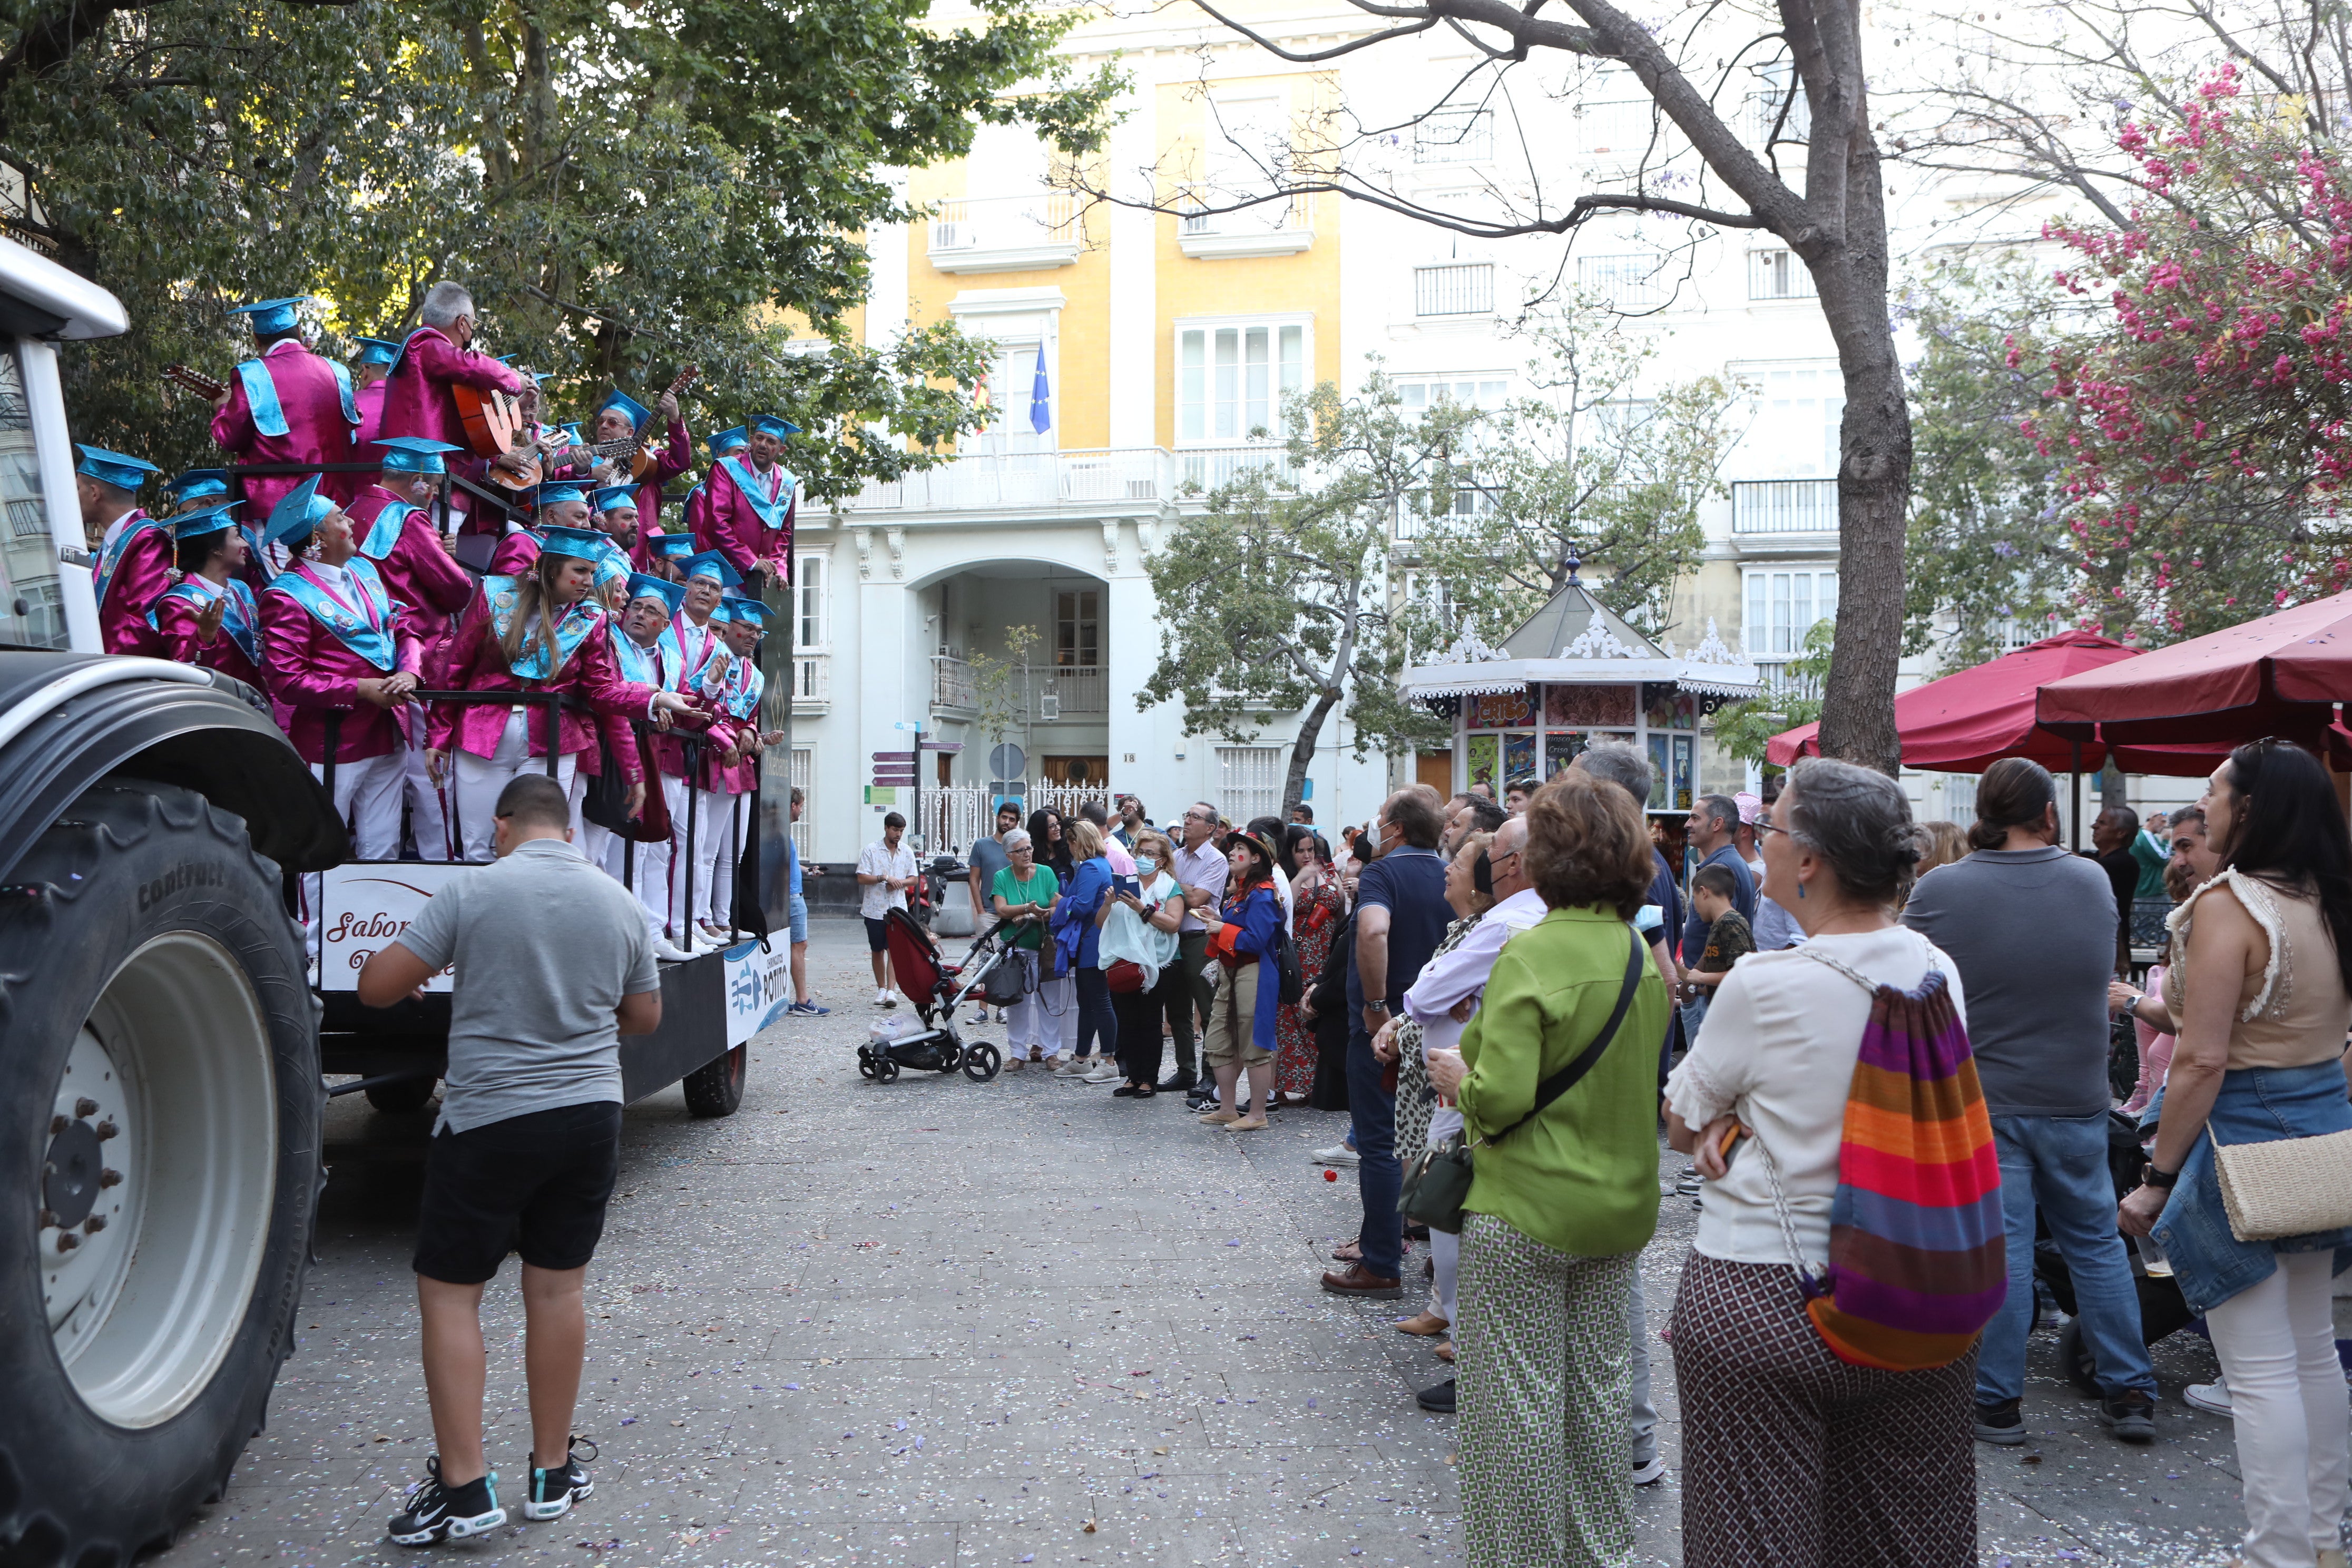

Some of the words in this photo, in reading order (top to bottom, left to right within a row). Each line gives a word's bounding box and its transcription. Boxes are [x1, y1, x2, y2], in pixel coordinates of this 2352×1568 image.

[63, 548, 75, 562] Hi
[1478, 701, 1530, 721] CRISO
[1124, 754, 1135, 762] 18
[327, 912, 411, 943] Sabor
[763, 964, 787, 1006] POTITO
